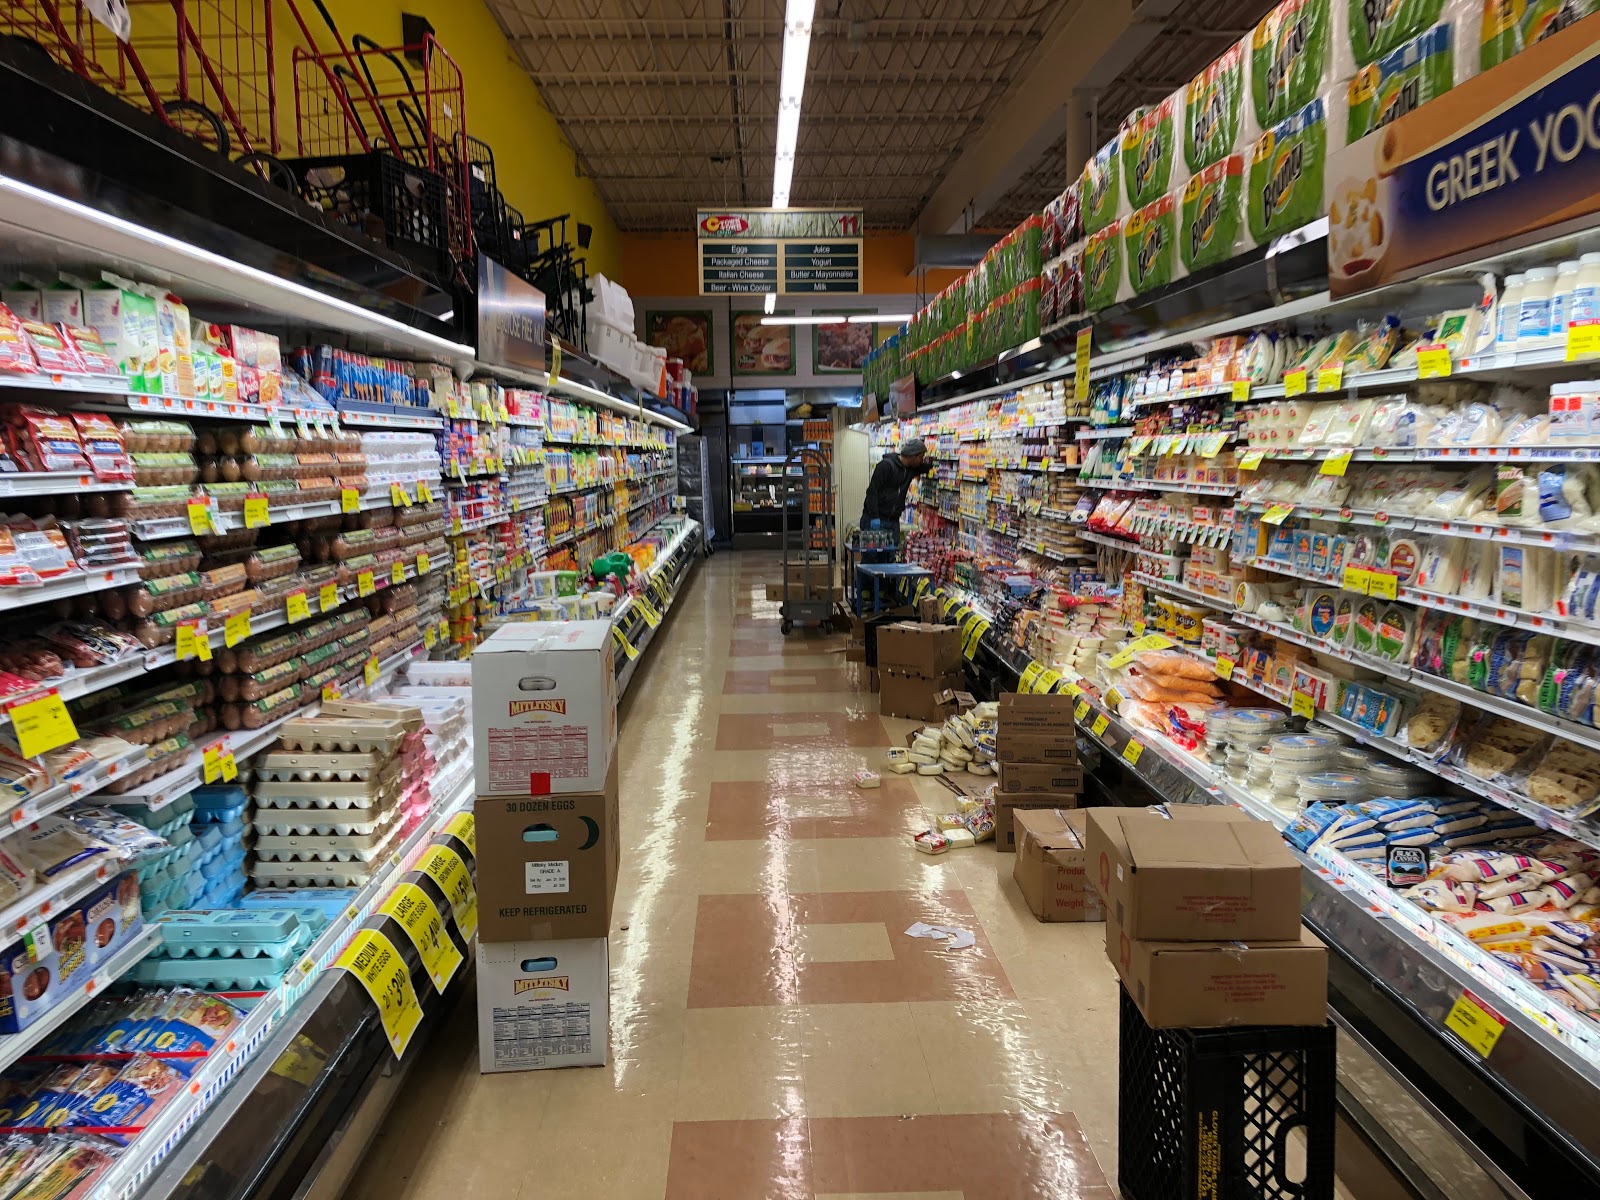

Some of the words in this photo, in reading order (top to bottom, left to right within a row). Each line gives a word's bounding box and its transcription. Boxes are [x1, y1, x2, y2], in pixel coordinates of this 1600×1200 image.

[1426, 129, 1520, 211] GREEK
[839, 215, 857, 235] 11
[731, 245, 748, 255] Eggs
[813, 245, 830, 254] Juice
[711, 257, 743, 267] Packaged
[744, 257, 769, 266] Cheese
[811, 258, 832, 267] Yogurt
[718, 270, 738, 279] Italian
[740, 270, 764, 279] Cheese
[790, 270, 810, 279] Butter
[815, 270, 854, 280] Mayonnaise
[711, 283, 726, 292] Beer
[732, 283, 749, 292] Wine
[750, 283, 771, 292] Cooler
[813, 283, 827, 291] Milk
[511, 699, 565, 716] MITLITSKY
[506, 802, 517, 813] 30
[520, 801, 549, 812] DOZEN
[552, 800, 575, 811] EGGS
[427, 855, 446, 875] LARGE
[438, 866, 453, 885] BROWN
[449, 856, 459, 873] EGGS
[1058, 866, 1085, 875] Produc
[1057, 882, 1074, 891] Unit
[393, 895, 415, 919] LARGE
[1056, 898, 1084, 909] Weight
[406, 910, 420, 929] WHITE
[416, 900, 428, 916] EGGS
[499, 907, 520, 917] KEEP
[523, 905, 587, 916] REFRIGERATED
[352, 941, 379, 972] MEDIUM
[365, 963, 382, 984] WHITE
[378, 949, 391, 967] EGGS
[514, 976, 568, 995] MITLITSKY
